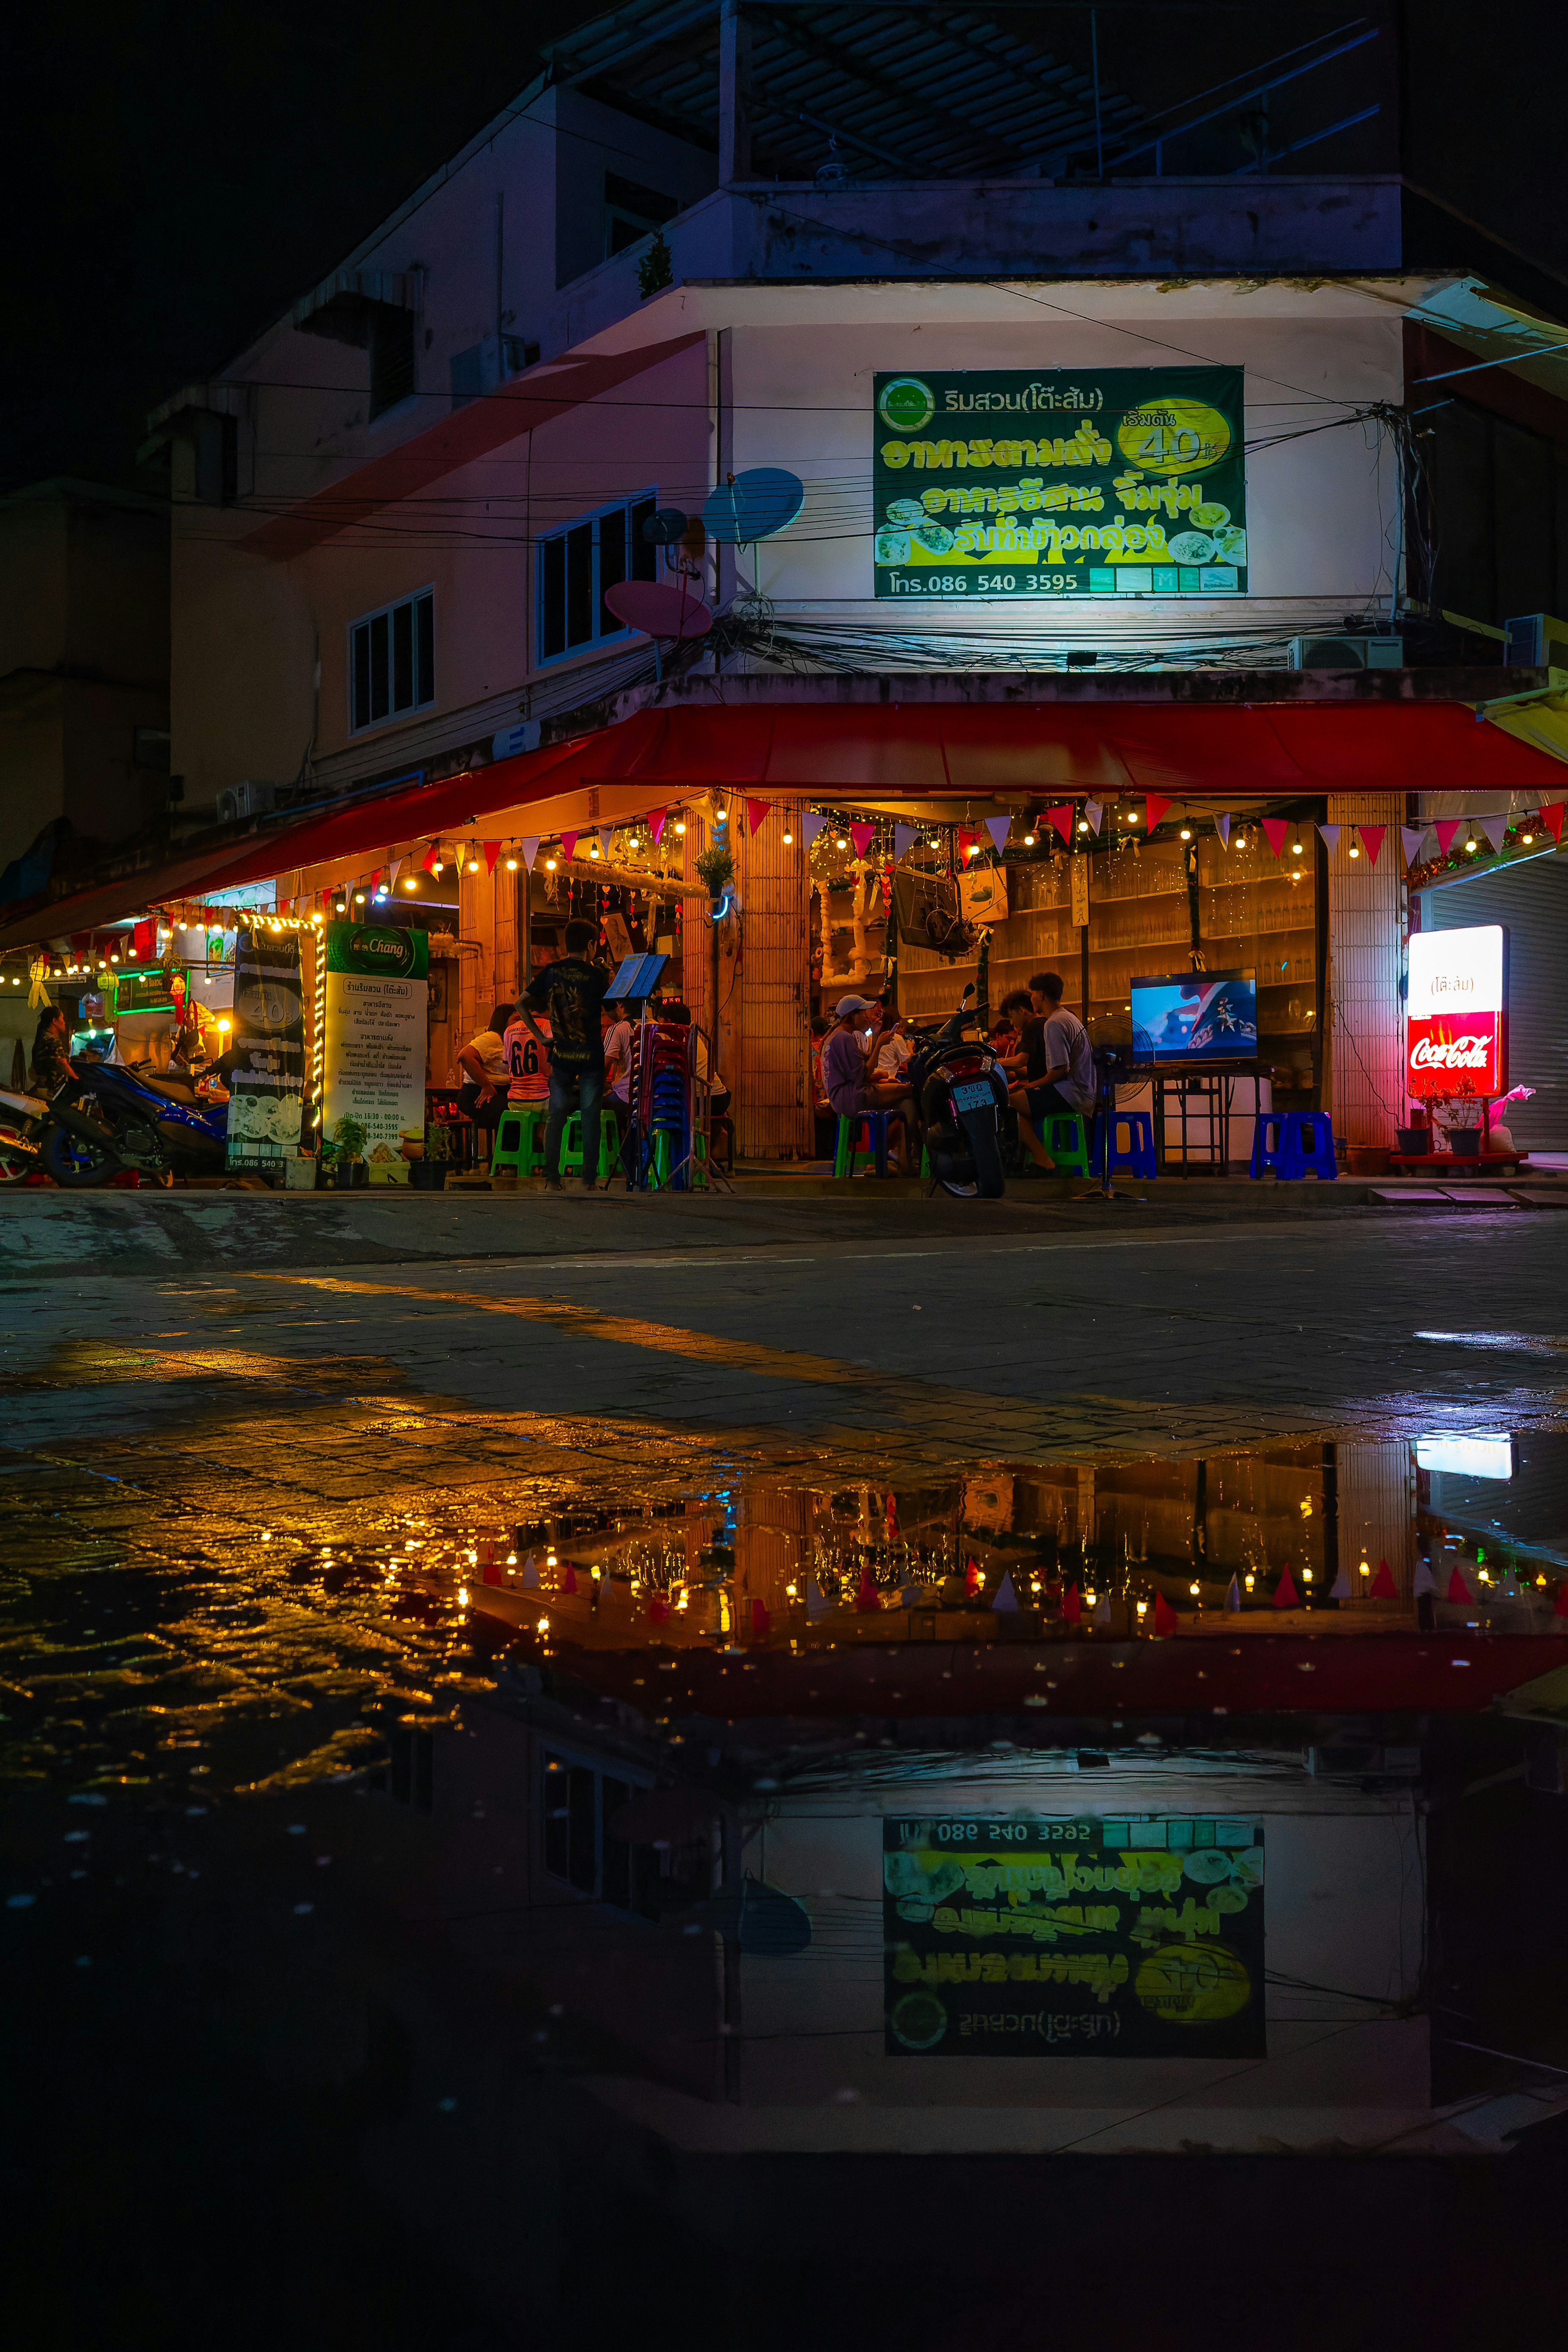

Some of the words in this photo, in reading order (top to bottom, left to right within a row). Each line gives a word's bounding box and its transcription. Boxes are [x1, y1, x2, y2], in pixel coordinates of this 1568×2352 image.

[944, 383, 1103, 410] ริมสวน(โต๊ะส้ม)
[1123, 406, 1176, 426] เริ่มต้น
[880, 419, 1112, 469] อาหารตามสั่ง
[920, 478, 1104, 513] อาหารอีสาน
[1113, 470, 1203, 519] จิ้มจุ่ม
[953, 514, 1165, 551] รับทำข้าวกล่อง
[890, 572, 967, 592] โทร.086
[978, 574, 1016, 590] 540
[1026, 574, 1077, 590] 3595
[370, 939, 403, 958] Chang
[347, 981, 381, 993] ร้านริมสวน
[384, 984, 408, 996] (โต๊ะส้ม)
[511, 1039, 538, 1077] 66
[968, 1099, 987, 1109] 173
